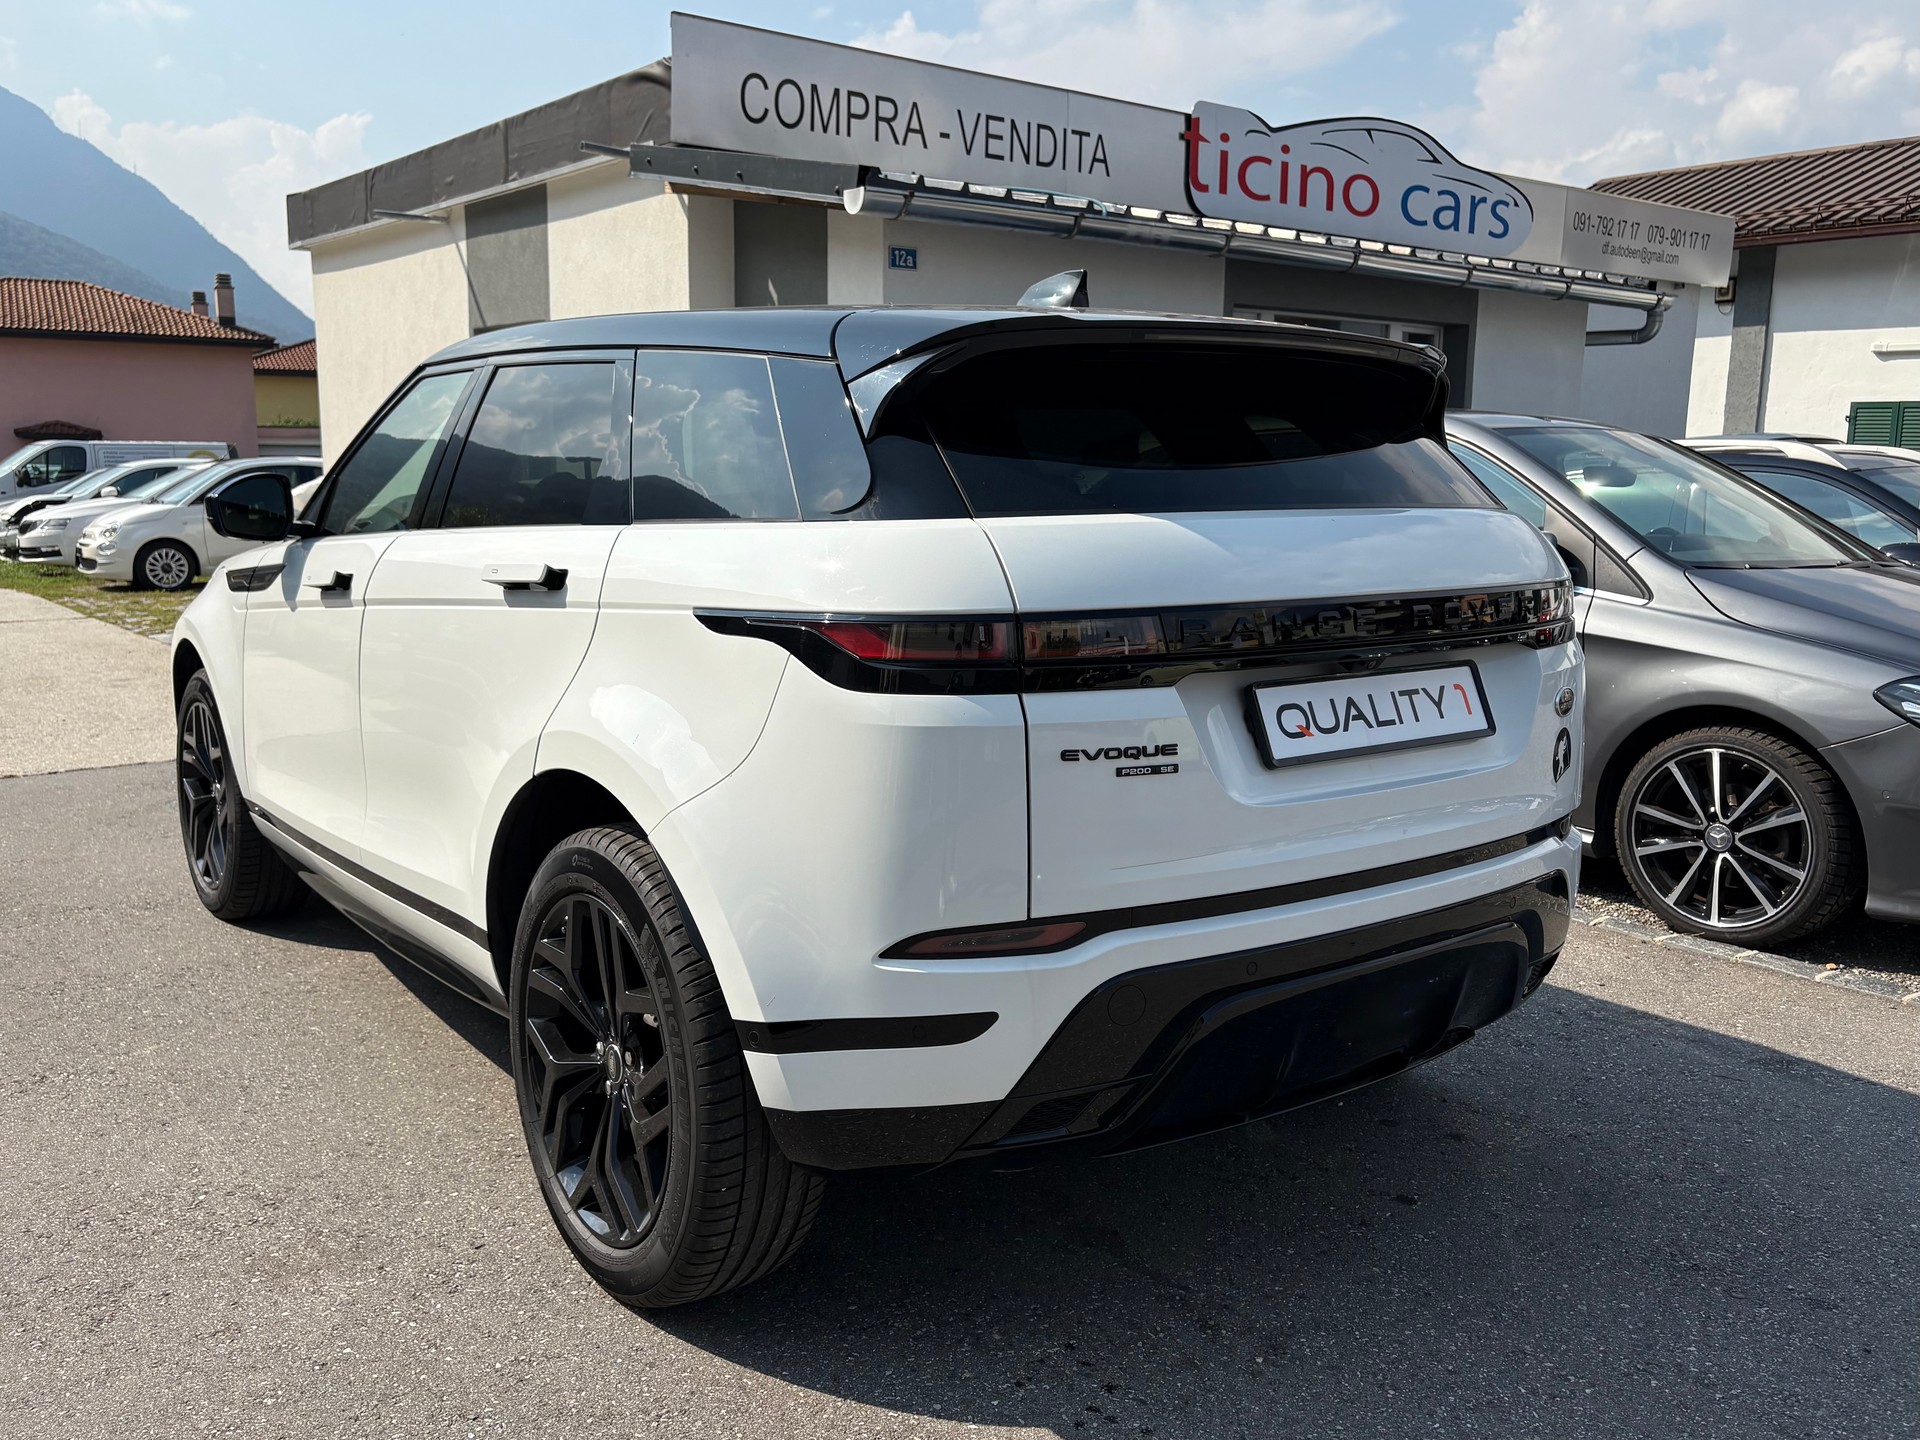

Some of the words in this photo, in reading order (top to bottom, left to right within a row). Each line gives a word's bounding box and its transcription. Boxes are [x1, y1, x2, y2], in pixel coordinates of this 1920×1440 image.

[740, 72, 929, 150] COMPRA
[956, 109, 1111, 177] VENDITA
[1184, 116, 1380, 218] ticino
[1400, 184, 1511, 239] cars
[1573, 211, 1614, 236] 091-792
[1617, 219, 1627, 238] 17
[1630, 223, 1640, 240] 17
[894, 250, 914, 267] 12a
[1179, 606, 1378, 648] RANGE
[1276, 685, 1446, 739] QUALITY
[1453, 683, 1473, 715] 1
[1060, 743, 1179, 762] EVOQUE
[1121, 767, 1152, 776] P200
[1160, 765, 1175, 774] SE
